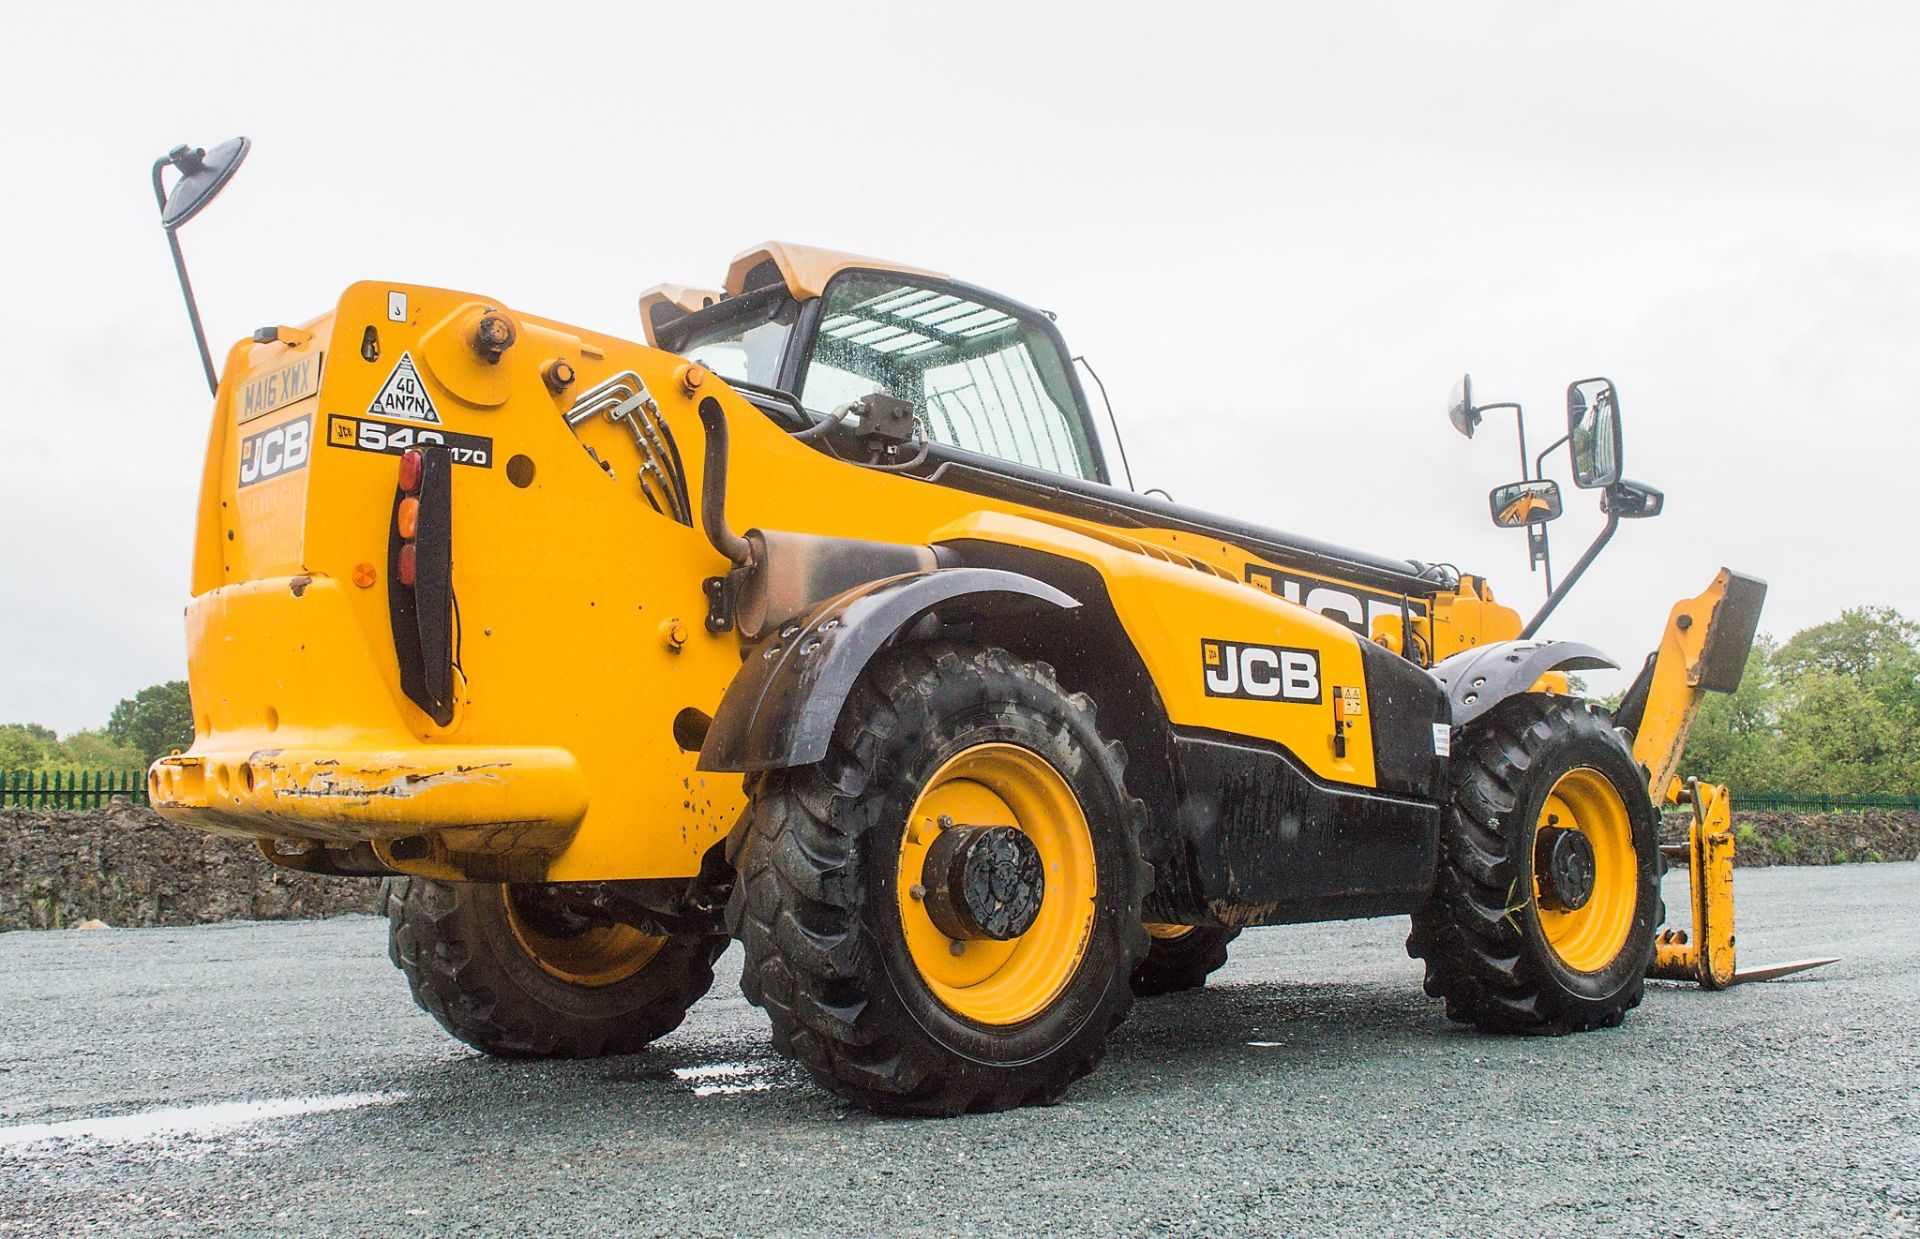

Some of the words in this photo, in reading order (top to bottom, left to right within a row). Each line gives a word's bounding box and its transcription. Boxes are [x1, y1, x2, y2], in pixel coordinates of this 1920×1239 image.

[385, 393, 425, 414] AN7N
[241, 420, 309, 483] JCB
[1206, 646, 1320, 700] JCB
